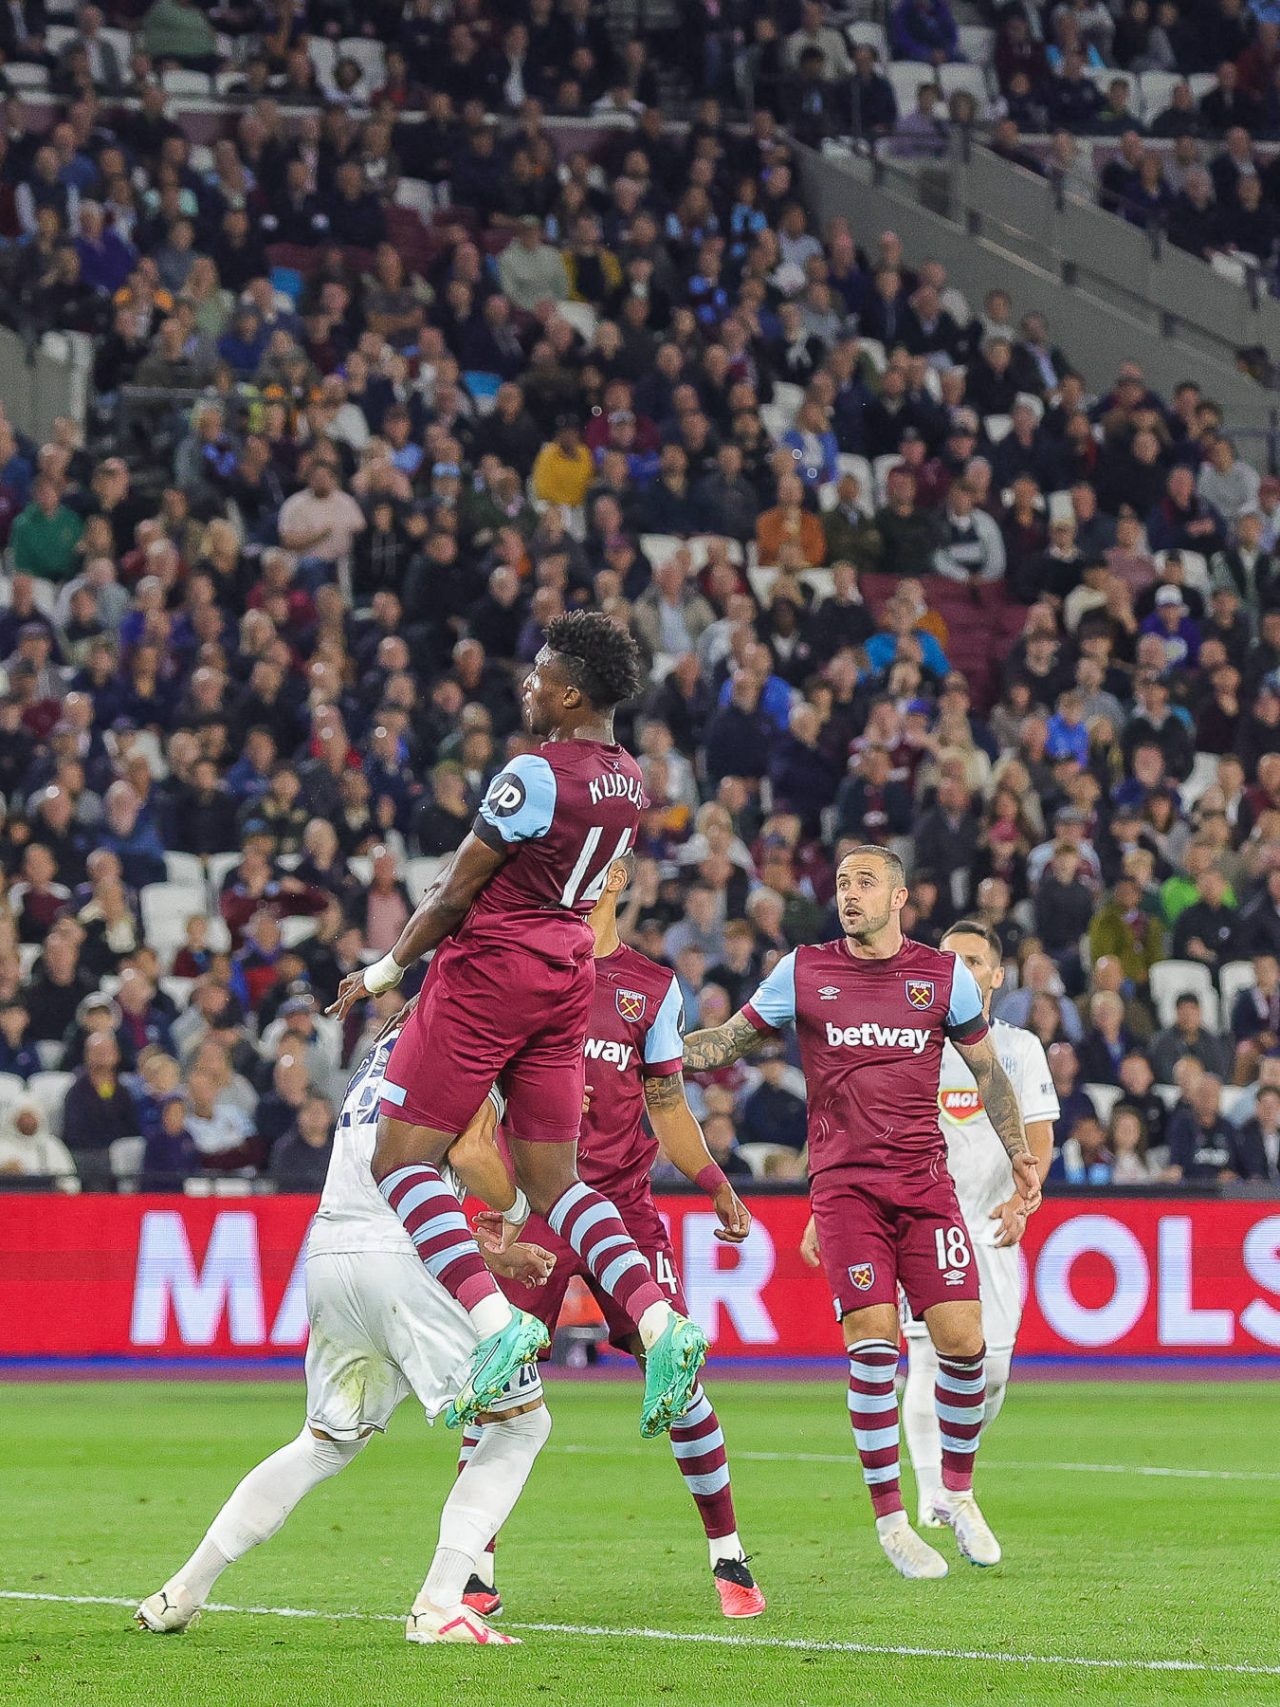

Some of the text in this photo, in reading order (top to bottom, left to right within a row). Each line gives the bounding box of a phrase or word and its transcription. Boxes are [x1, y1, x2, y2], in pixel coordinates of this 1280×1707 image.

[490, 781, 522, 809] JD
[584, 1038, 634, 1072] way
[825, 1022, 931, 1054] betway
[934, 1226, 970, 1270] 18
[656, 1251, 677, 1294] 4
